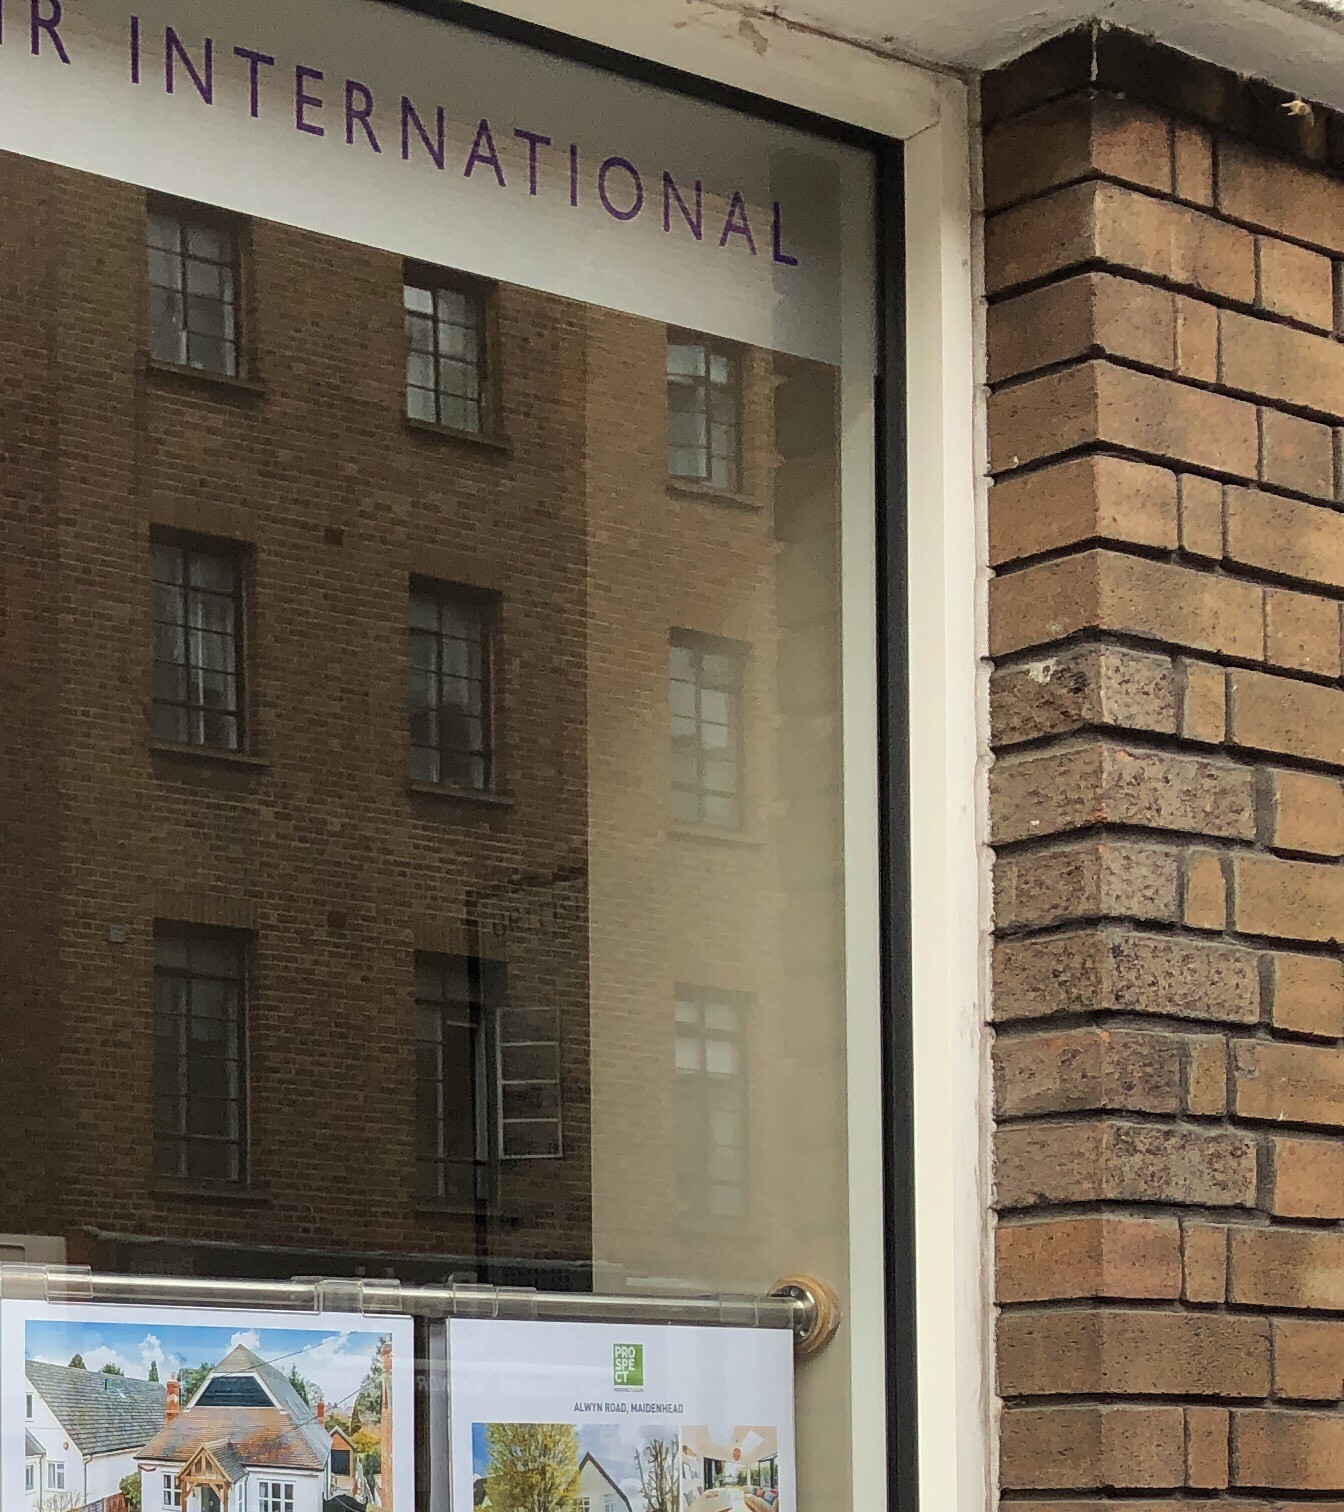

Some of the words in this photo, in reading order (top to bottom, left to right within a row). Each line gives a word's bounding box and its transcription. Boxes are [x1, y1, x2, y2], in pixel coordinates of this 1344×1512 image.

[128, 14, 799, 268] INTERNATIONAL
[615, 1346, 636, 1359] PRO
[615, 1359, 635, 1371] SPE
[615, 1371, 629, 1383] CT
[574, 1402, 603, 1413] ALWYN
[605, 1403, 629, 1414] ROAD,
[631, 1403, 684, 1414] MAIDENHEAD
